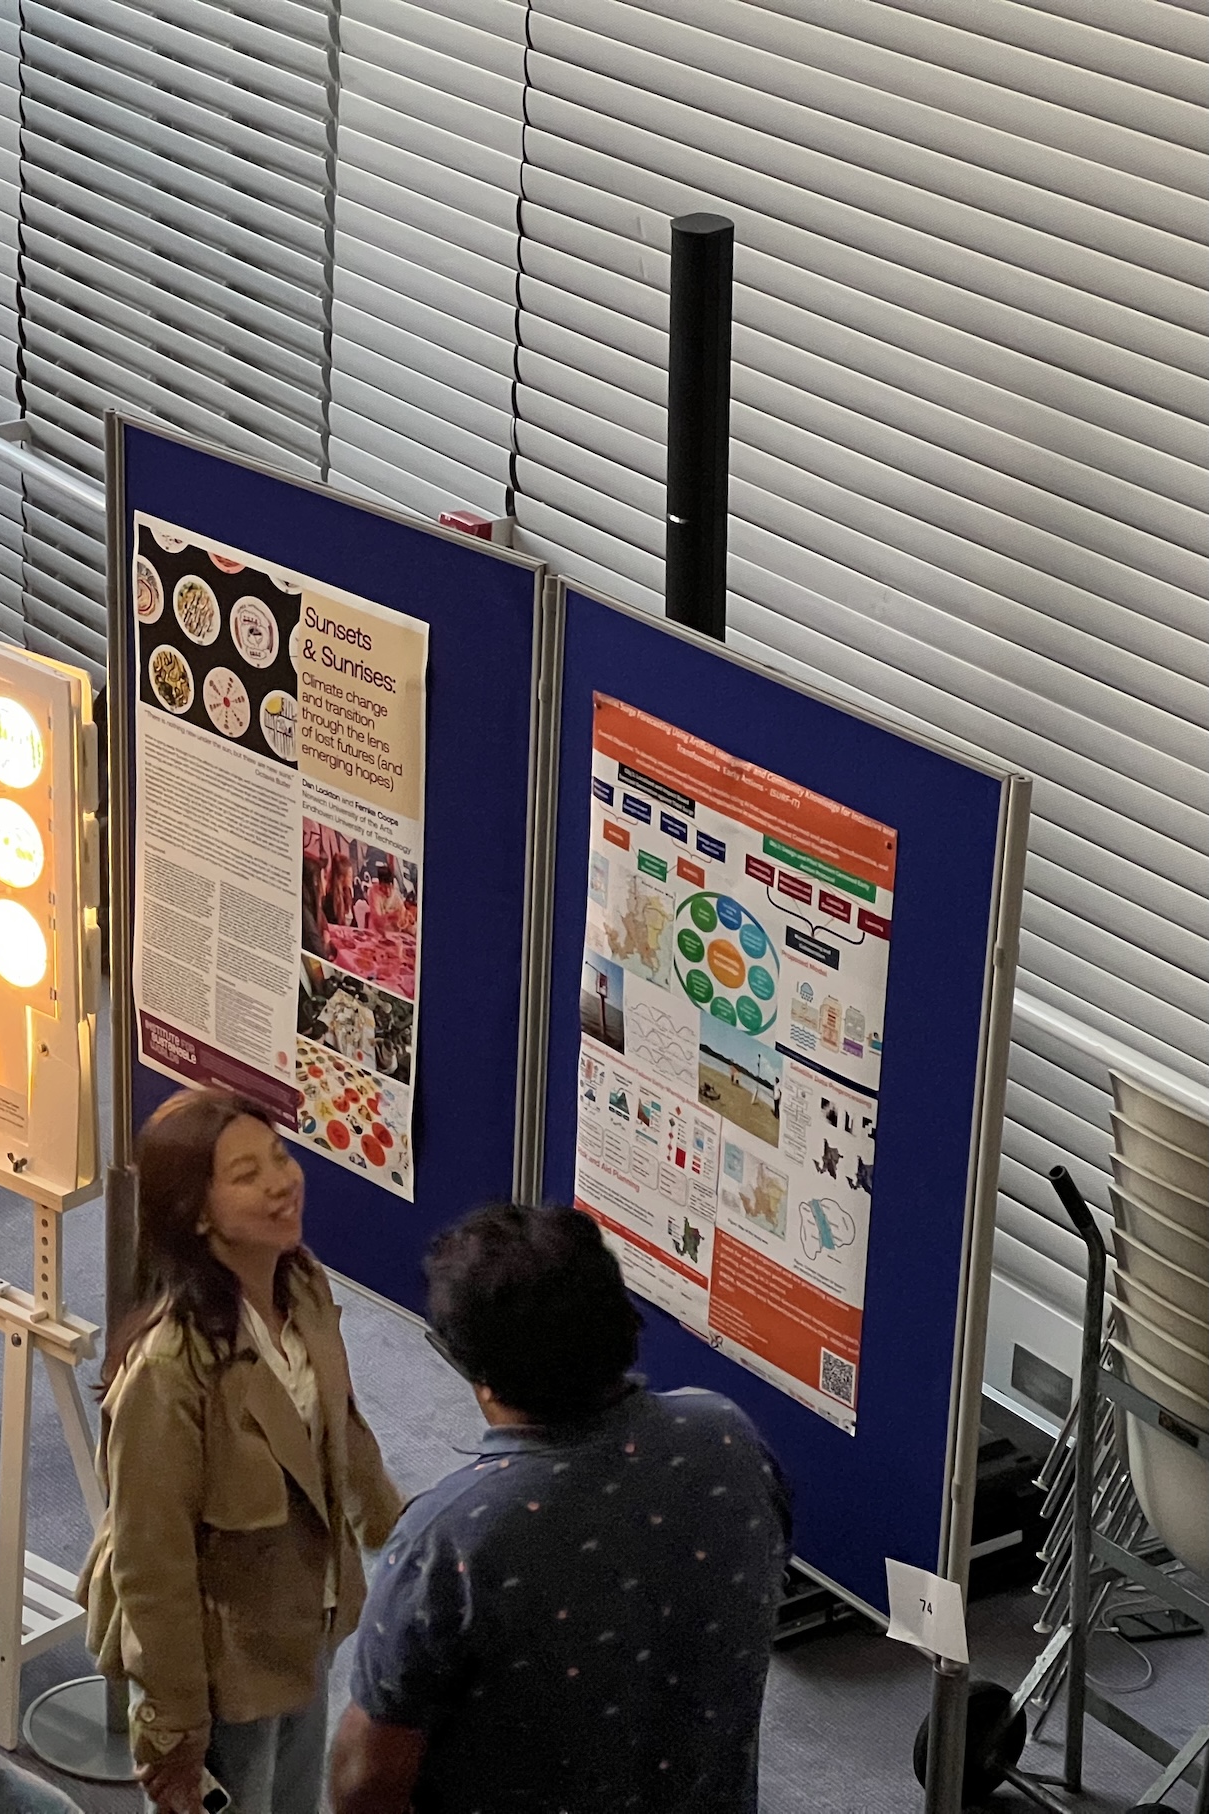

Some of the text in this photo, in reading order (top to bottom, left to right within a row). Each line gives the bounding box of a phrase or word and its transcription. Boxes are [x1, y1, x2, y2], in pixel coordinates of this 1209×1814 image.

[304, 606, 372, 650] Sunsets
[302, 637, 396, 692] & Sunrises:
[302, 672, 387, 719] Climate change
[302, 689, 374, 728] and transition
[301, 723, 402, 778] of lost futures (and
[302, 707, 389, 753] through the lens
[301, 742, 394, 792] emerging hopes)
[302, 779, 314, 789] Dan
[341, 797, 353, 806] and
[302, 801, 411, 855] Eindhoven University of Technology
[328, 802, 358, 821] University
[359, 814, 366, 824] of
[367, 819, 378, 828] the
[379, 824, 392, 834] Arts
[919, 1598, 933, 1615] 74
